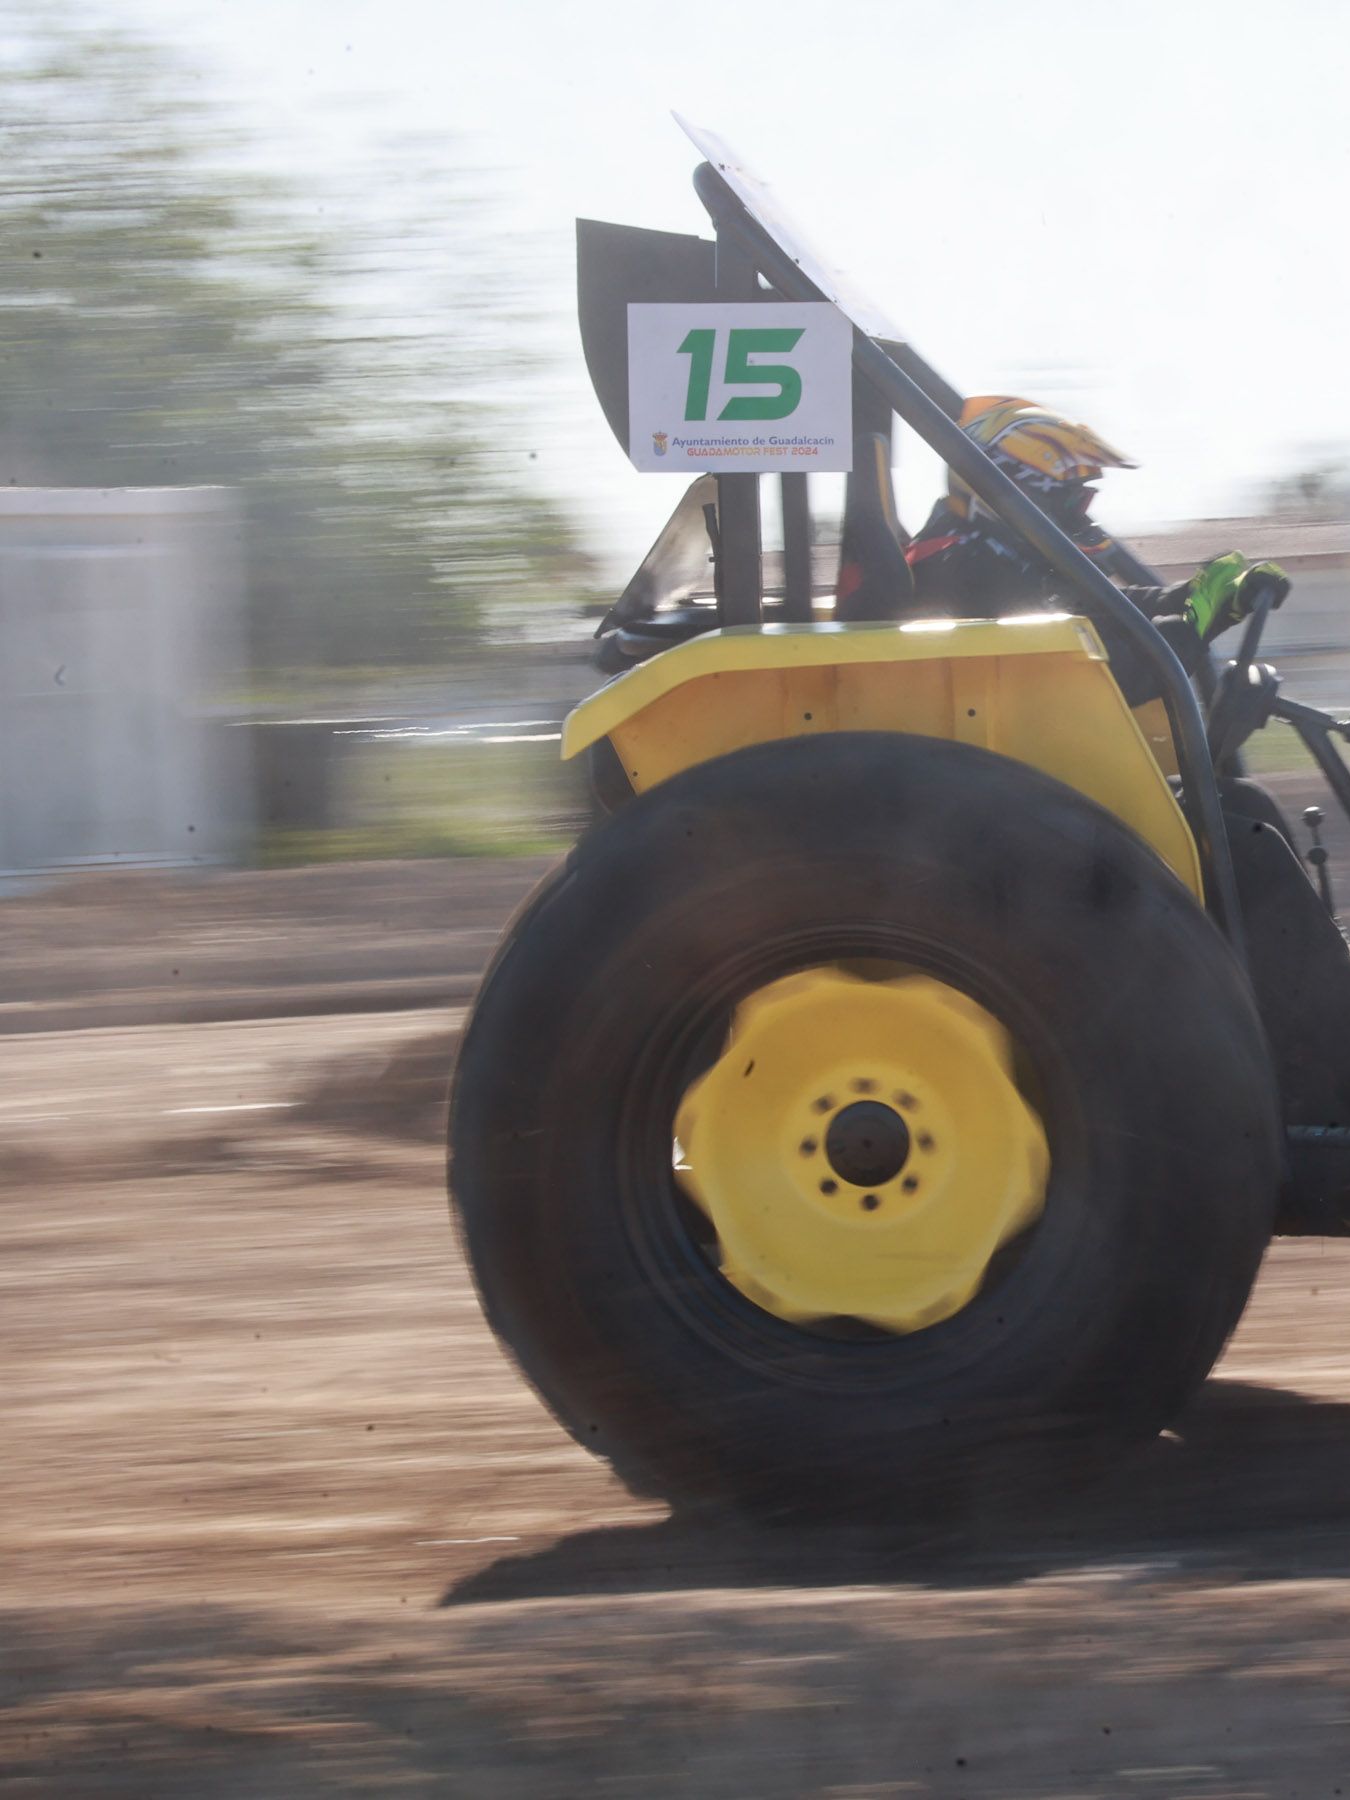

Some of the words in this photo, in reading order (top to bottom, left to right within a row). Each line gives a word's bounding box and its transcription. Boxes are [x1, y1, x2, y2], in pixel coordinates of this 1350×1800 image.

[676, 328, 806, 421] 15
[671, 437, 749, 448] Ayuntamiento
[752, 436, 766, 446] de
[686, 447, 760, 457] GUADAMOTOR
[763, 447, 788, 456] FEST
[791, 447, 819, 456] 2024
